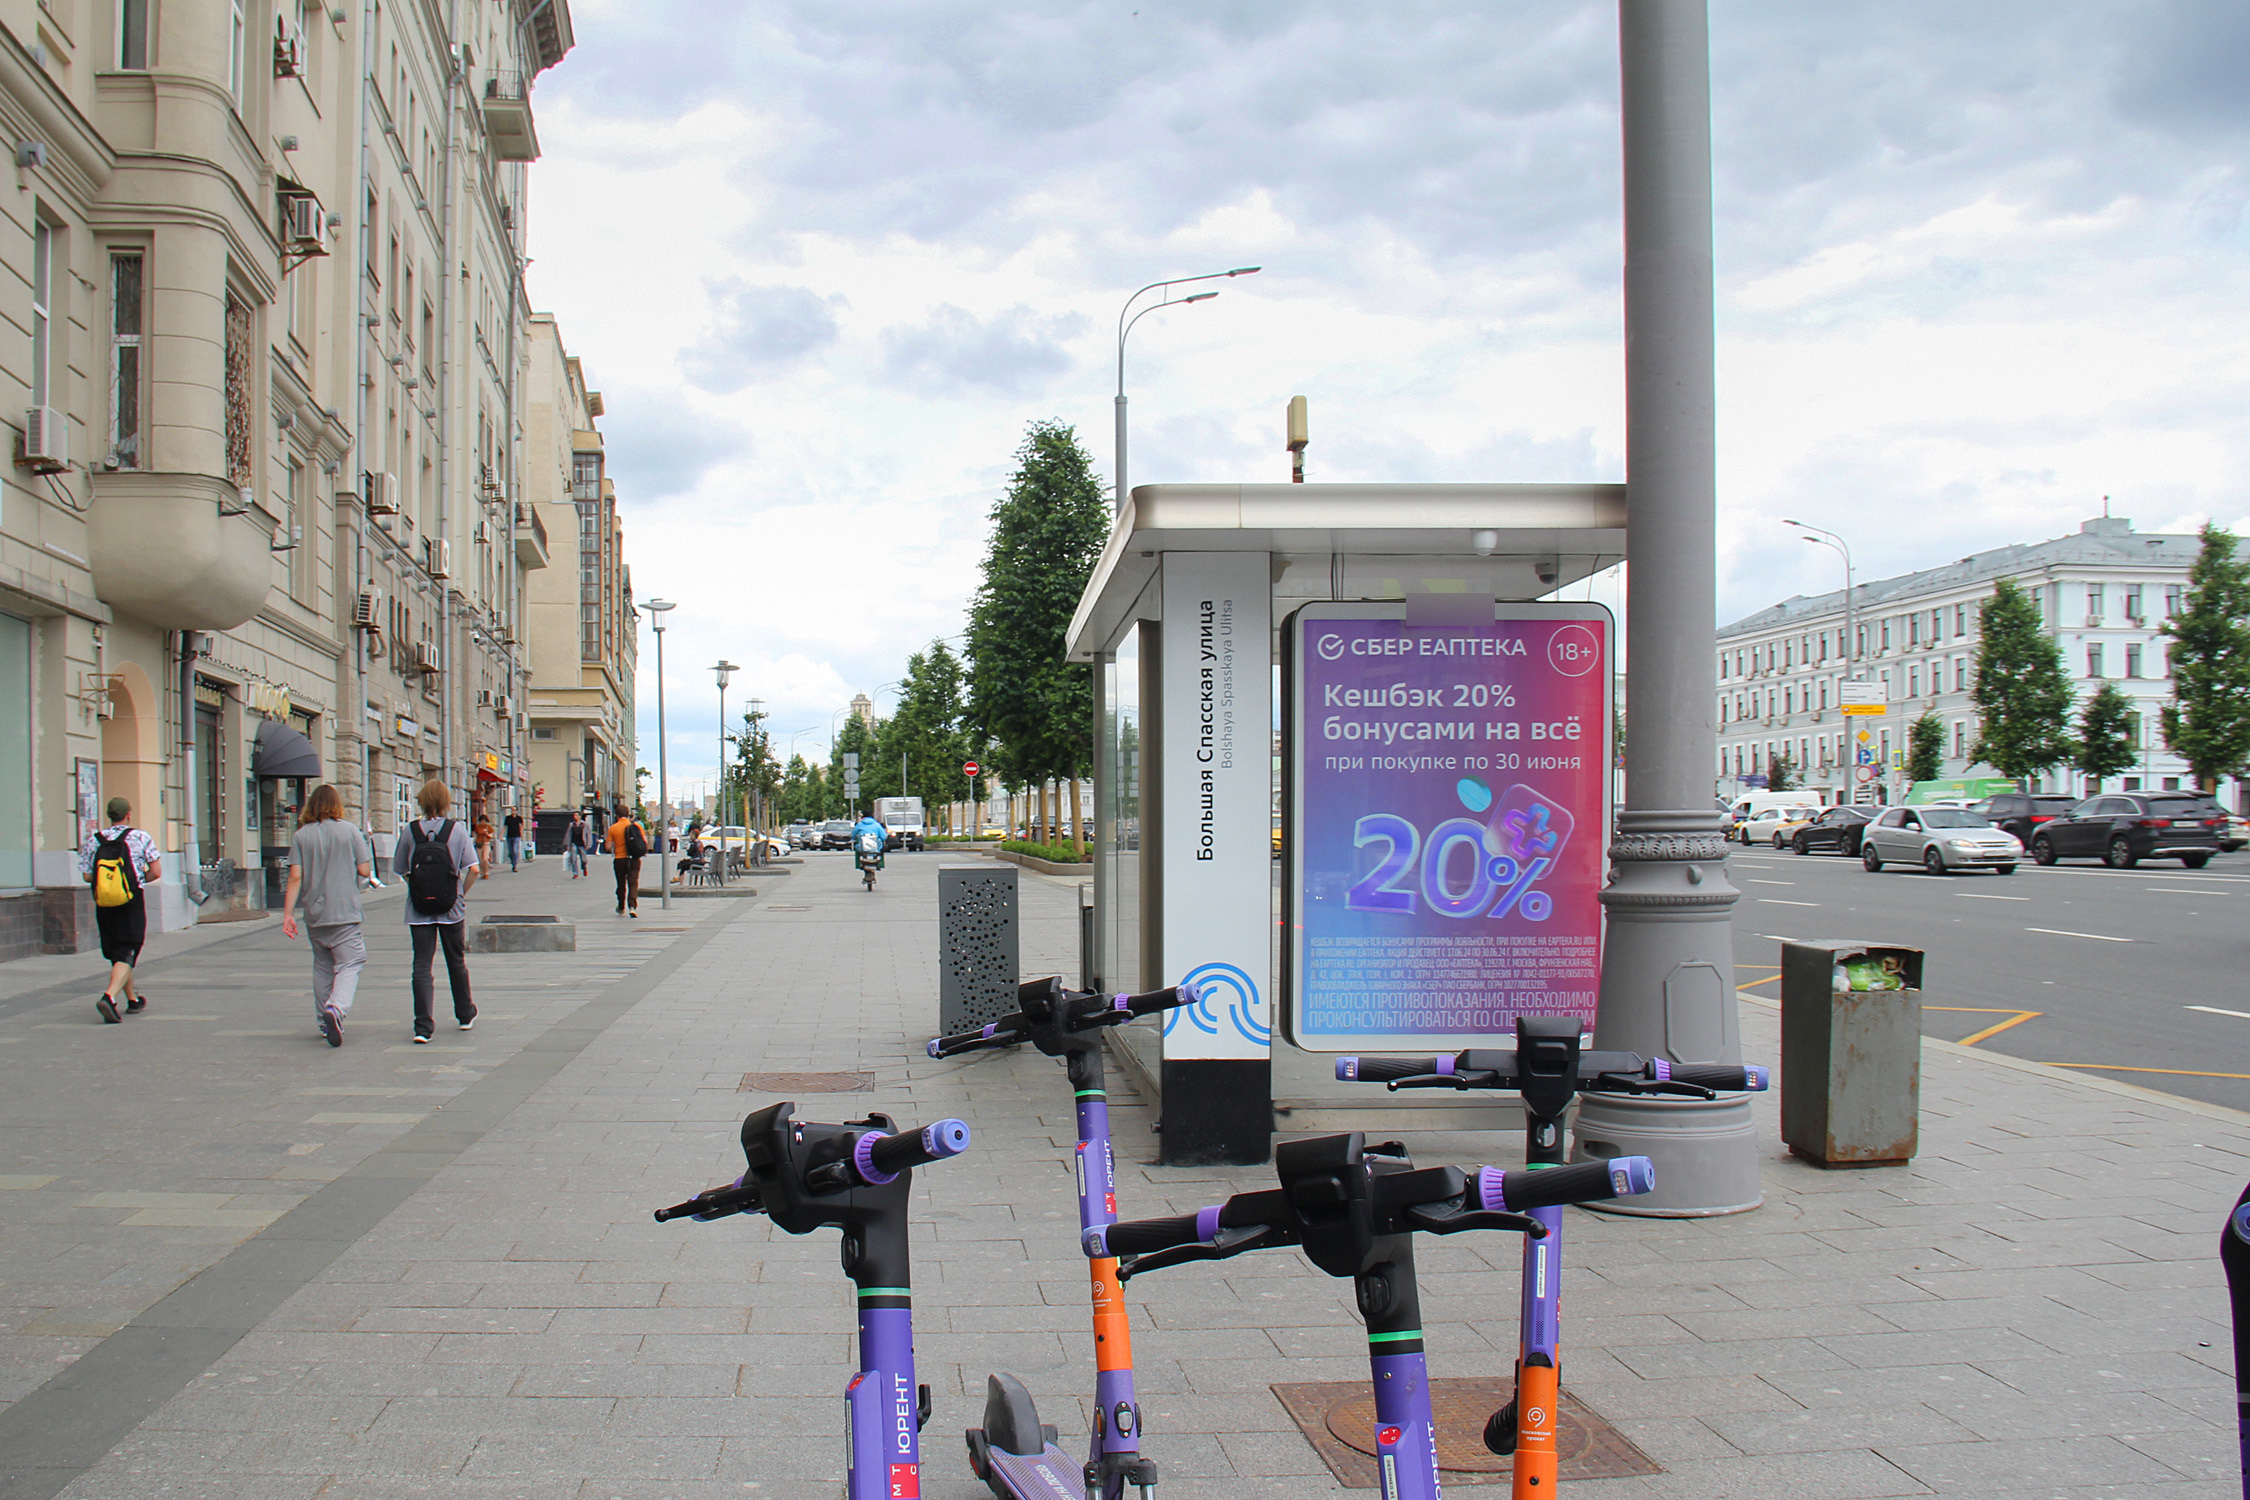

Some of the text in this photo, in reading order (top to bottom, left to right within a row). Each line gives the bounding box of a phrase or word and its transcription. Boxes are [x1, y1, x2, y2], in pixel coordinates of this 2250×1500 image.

[1351, 638, 1527, 656] СБЕР ЕАПТЕКА
[1556, 642, 1592, 661] 18+
[1221, 599, 1235, 769] Bolshaya Spasskaya Ulitsa
[1324, 682, 1516, 708] Кешбэк 20%
[1196, 600, 1217, 861] Большая Спасская улица
[1323, 715, 1582, 746] бонусами на всё
[1325, 753, 1581, 774] при покупке по 30 июня
[1344, 813, 1553, 922] 20%
[1309, 992, 1596, 1009] ИМЕЮТСЯ ПРОТИВОПОКАЗАНИЯ. НЕОБХОДИМО
[1309, 1011, 1470, 1028] ПРОКОНСУЛЬТИРОВАТЬСЯ
[1473, 1011, 1490, 1028] СО
[1103, 1139, 1114, 1188] ЮРЕНТ
[894, 1372, 911, 1454] ЮРЕНТ
